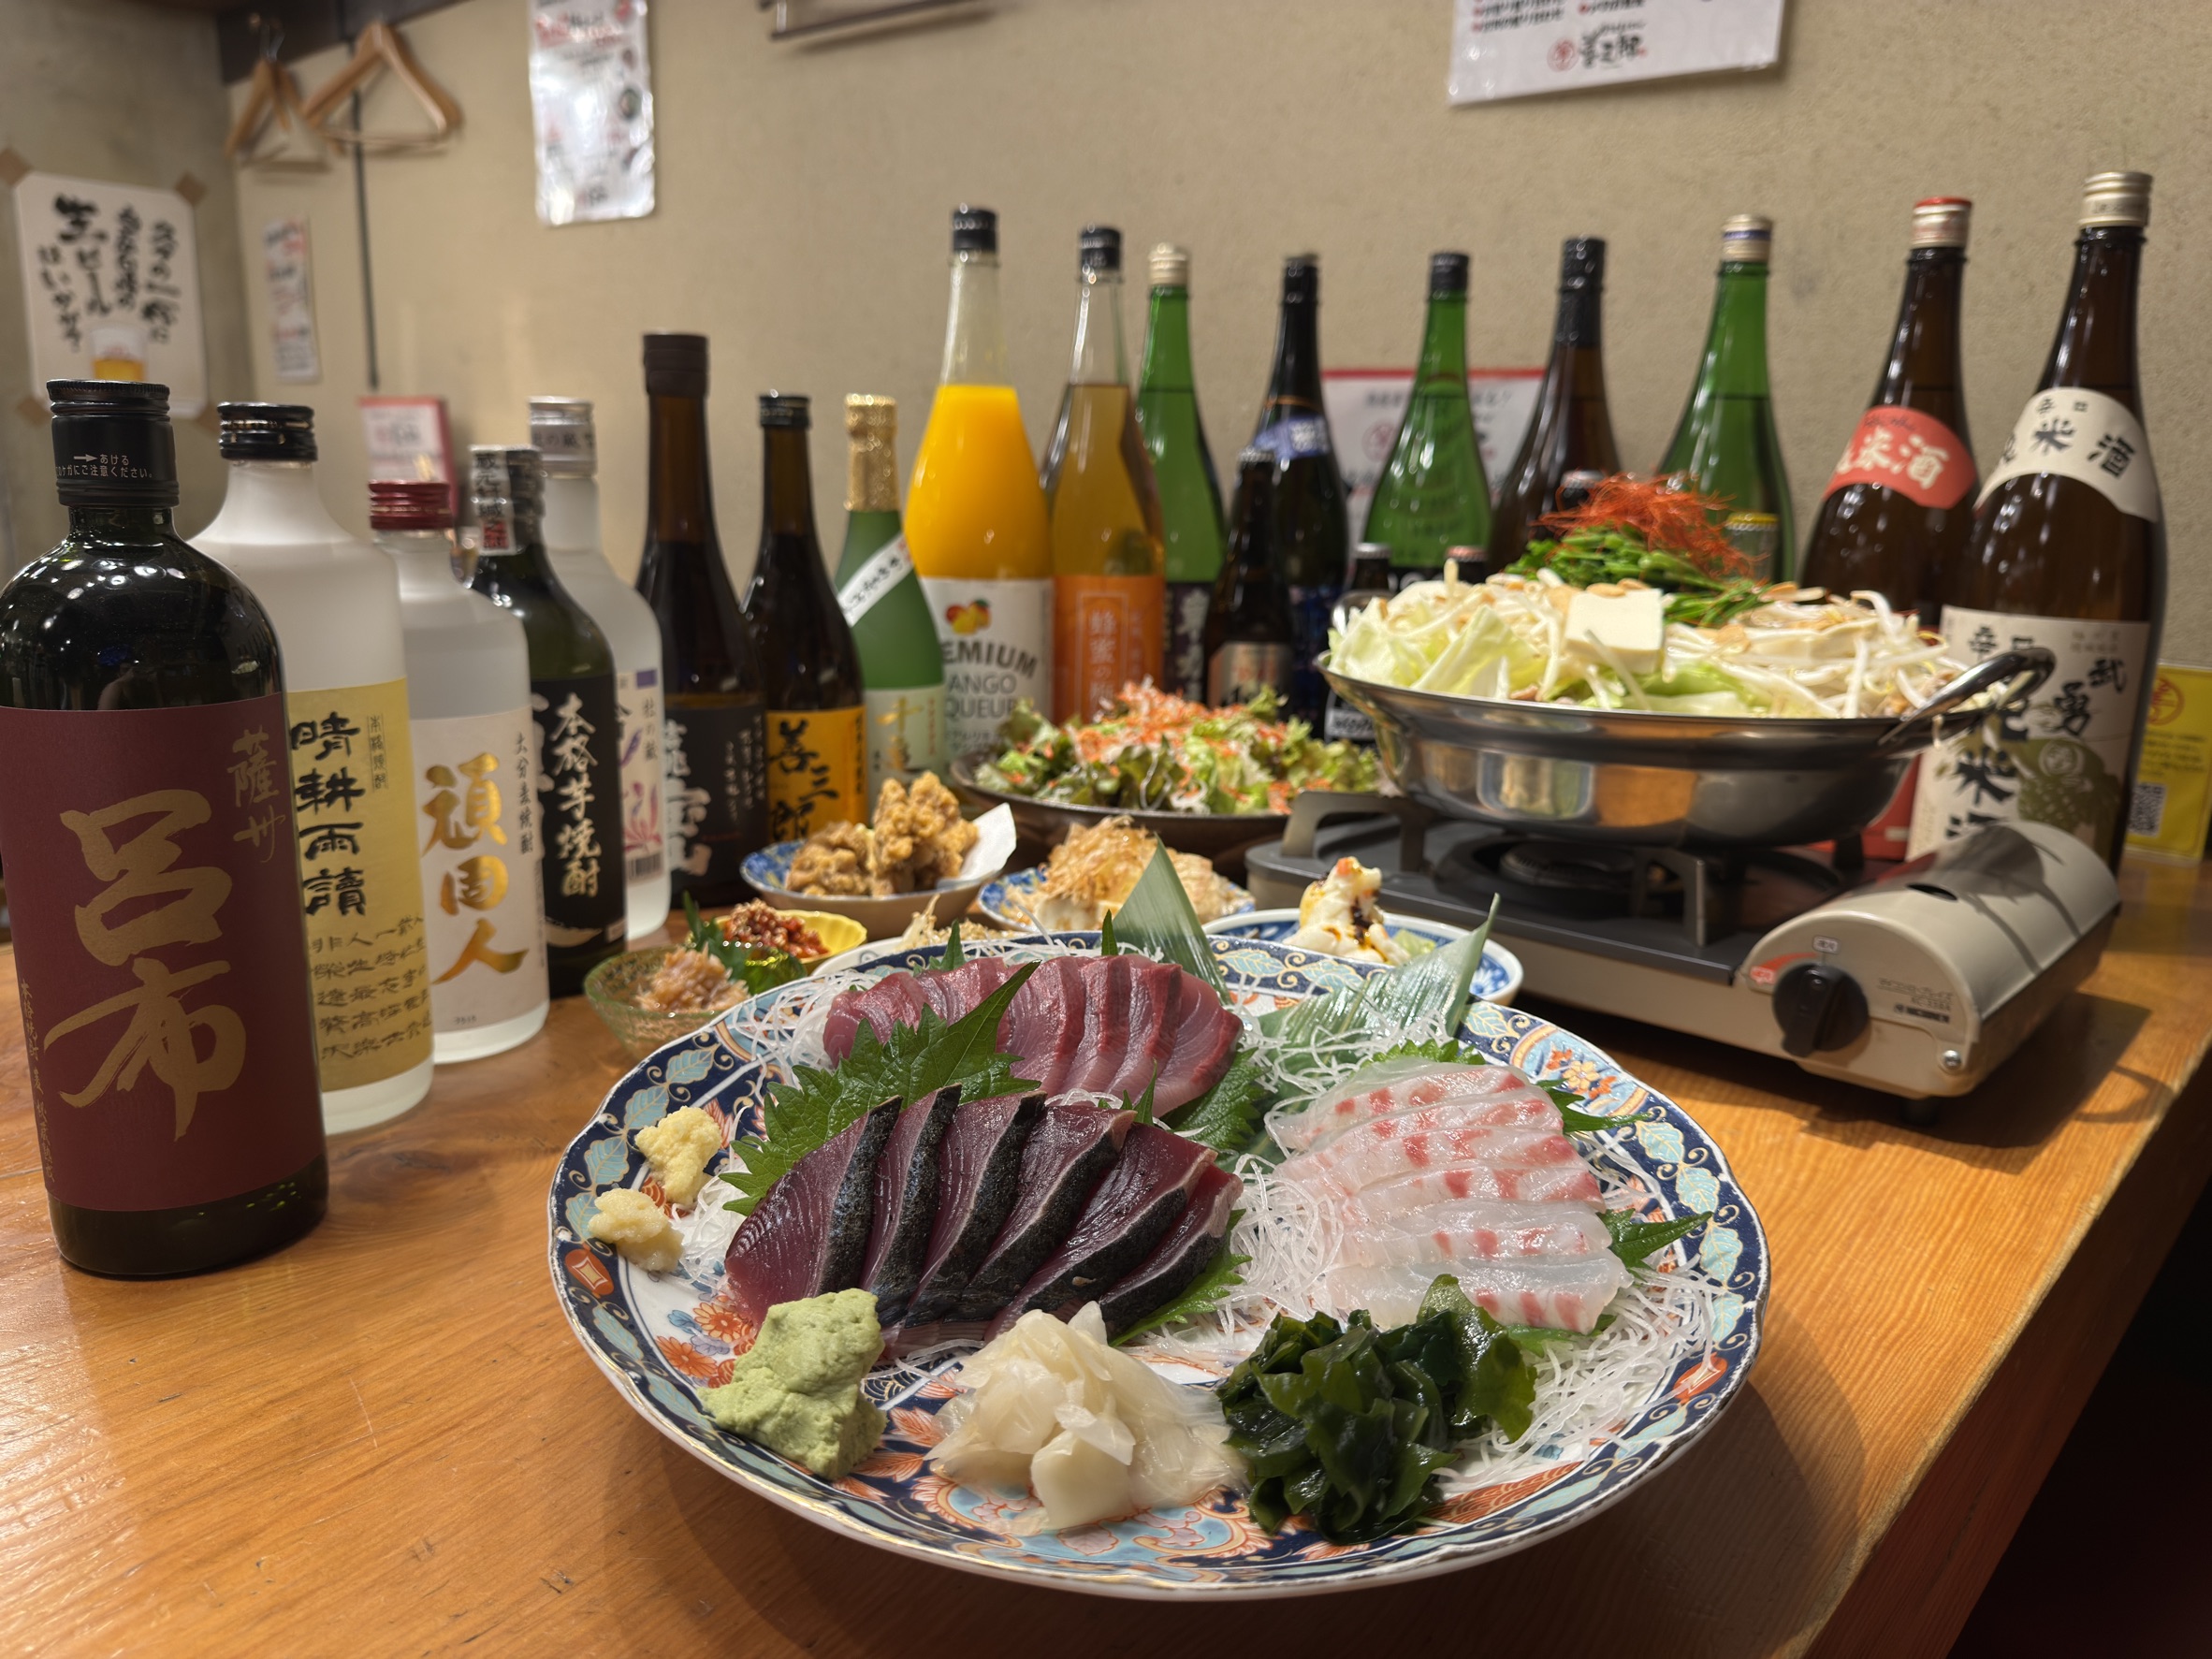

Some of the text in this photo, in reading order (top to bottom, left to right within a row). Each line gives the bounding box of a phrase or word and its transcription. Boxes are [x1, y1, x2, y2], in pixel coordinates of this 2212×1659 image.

[99, 453, 130, 466] あける
[940, 639, 1038, 679] EMIUM
[948, 671, 1017, 694] ANGO
[943, 697, 1017, 721] QUEU
[226, 725, 287, 864] 薩州
[550, 691, 602, 897] 本格芋焼酎
[421, 752, 530, 985] 頑固人
[43, 788, 247, 1142] 呂布
